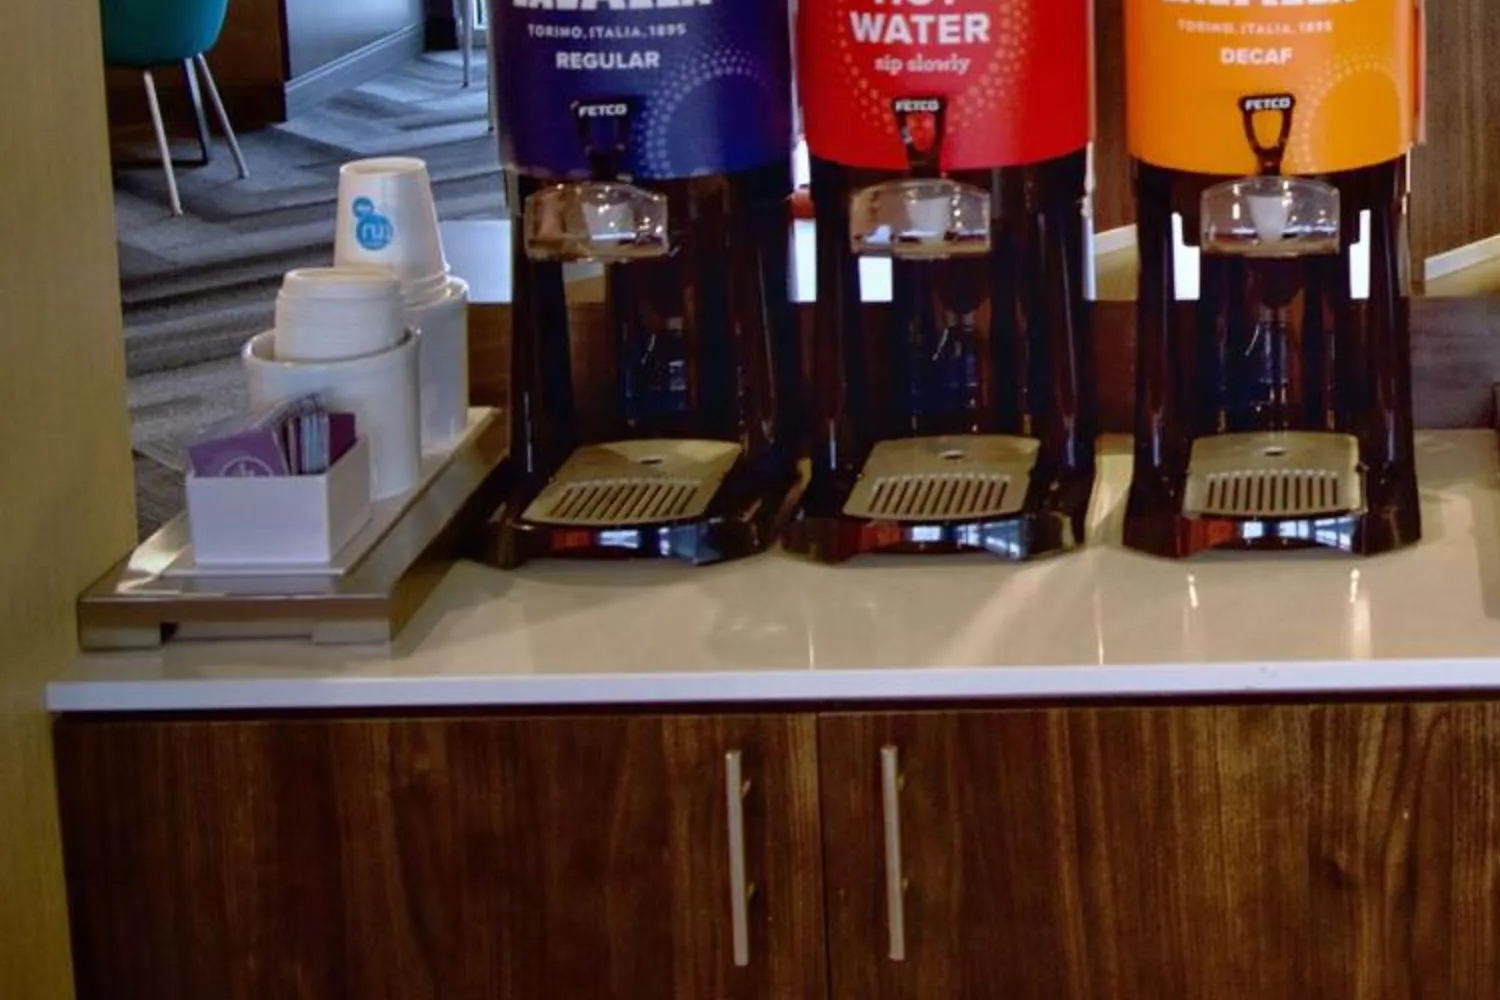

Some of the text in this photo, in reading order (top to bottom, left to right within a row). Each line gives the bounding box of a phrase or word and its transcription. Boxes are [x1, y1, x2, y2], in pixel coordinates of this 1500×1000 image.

[849, 10, 991, 44] WATER
[555, 51, 661, 70] REGULAR
[874, 52, 972, 76] sip slowly
[1220, 47, 1293, 65] DECAF
[578, 103, 627, 118] FETCO
[895, 99, 940, 113] FETCO
[1245, 97, 1291, 111] FETCO
